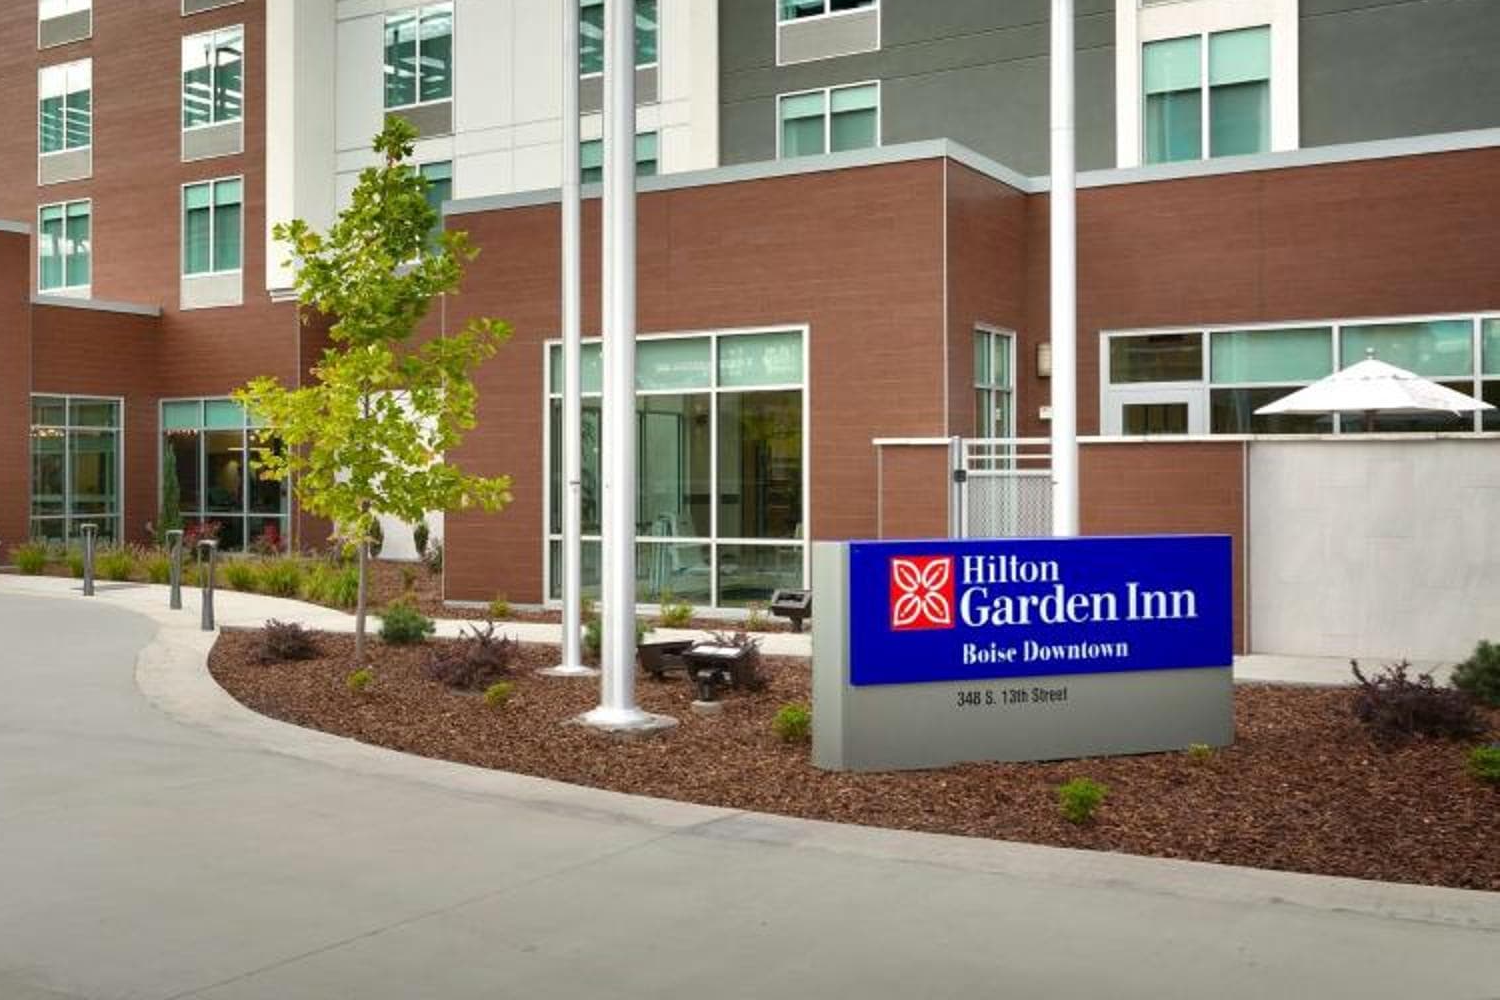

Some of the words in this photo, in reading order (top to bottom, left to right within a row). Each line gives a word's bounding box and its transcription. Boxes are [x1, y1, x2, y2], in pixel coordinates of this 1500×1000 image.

[962, 555, 1059, 584] Hilton
[960, 584, 1119, 628] Garden
[1125, 581, 1199, 621] Inn
[963, 641, 1018, 665] Boise
[1023, 639, 1130, 663] Downtown
[957, 691, 981, 707] 348
[985, 690, 997, 705] S.
[1001, 687, 1029, 705] 13th
[1031, 686, 1068, 703] Street
